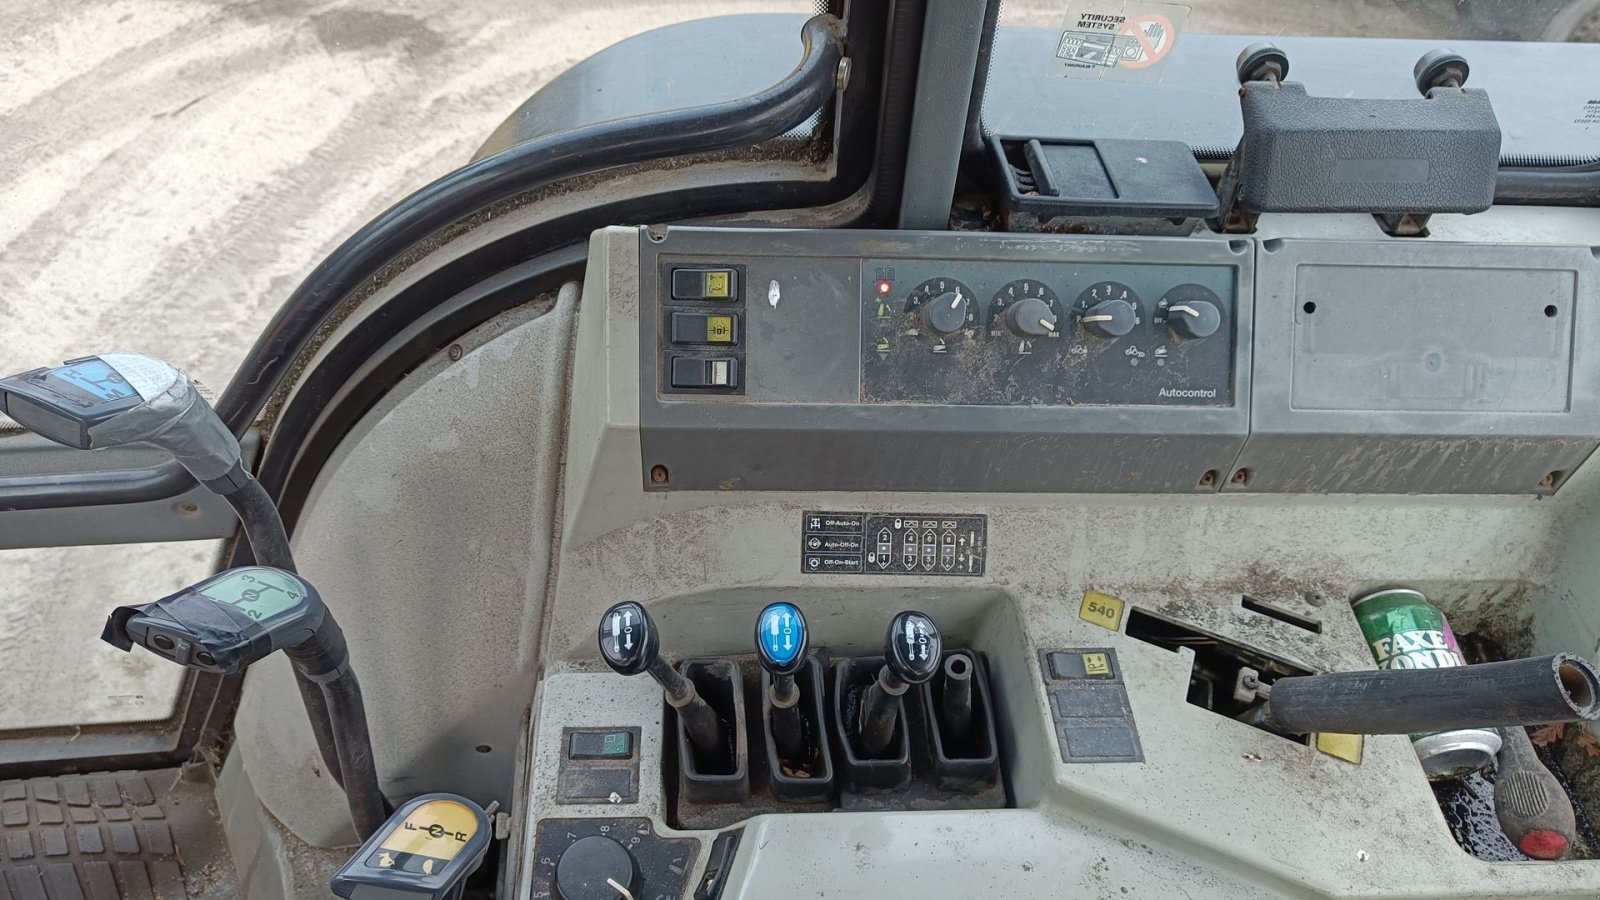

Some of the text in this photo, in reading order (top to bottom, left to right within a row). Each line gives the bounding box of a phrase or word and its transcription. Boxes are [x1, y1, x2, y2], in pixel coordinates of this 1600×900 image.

[924, 285, 929, 293] 4
[939, 281, 945, 289] 5
[1023, 283, 1029, 291] 5
[1106, 285, 1111, 293] 3
[955, 286, 961, 294] 6
[1008, 287, 1013, 295] 4
[1092, 289, 1097, 297] 2
[1122, 290, 1128, 298] 4
[998, 298, 1003, 306] 3
[1081, 300, 1086, 308] 1
[1132, 302, 1137, 310] 5
[1135, 316, 1140, 325] 6
[1158, 387, 1216, 398] Autocontrol
[241, 574, 256, 583] 3
[285, 590, 300, 600] 4
[1088, 601, 1115, 619] 540
[247, 609, 262, 620] 2
[1372, 630, 1449, 661] FAXE
[404, 821, 417, 831] F
[454, 831, 467, 843] R
[567, 831, 577, 839] 7
[630, 836, 641, 845] 9
[540, 857, 550, 865] 6
